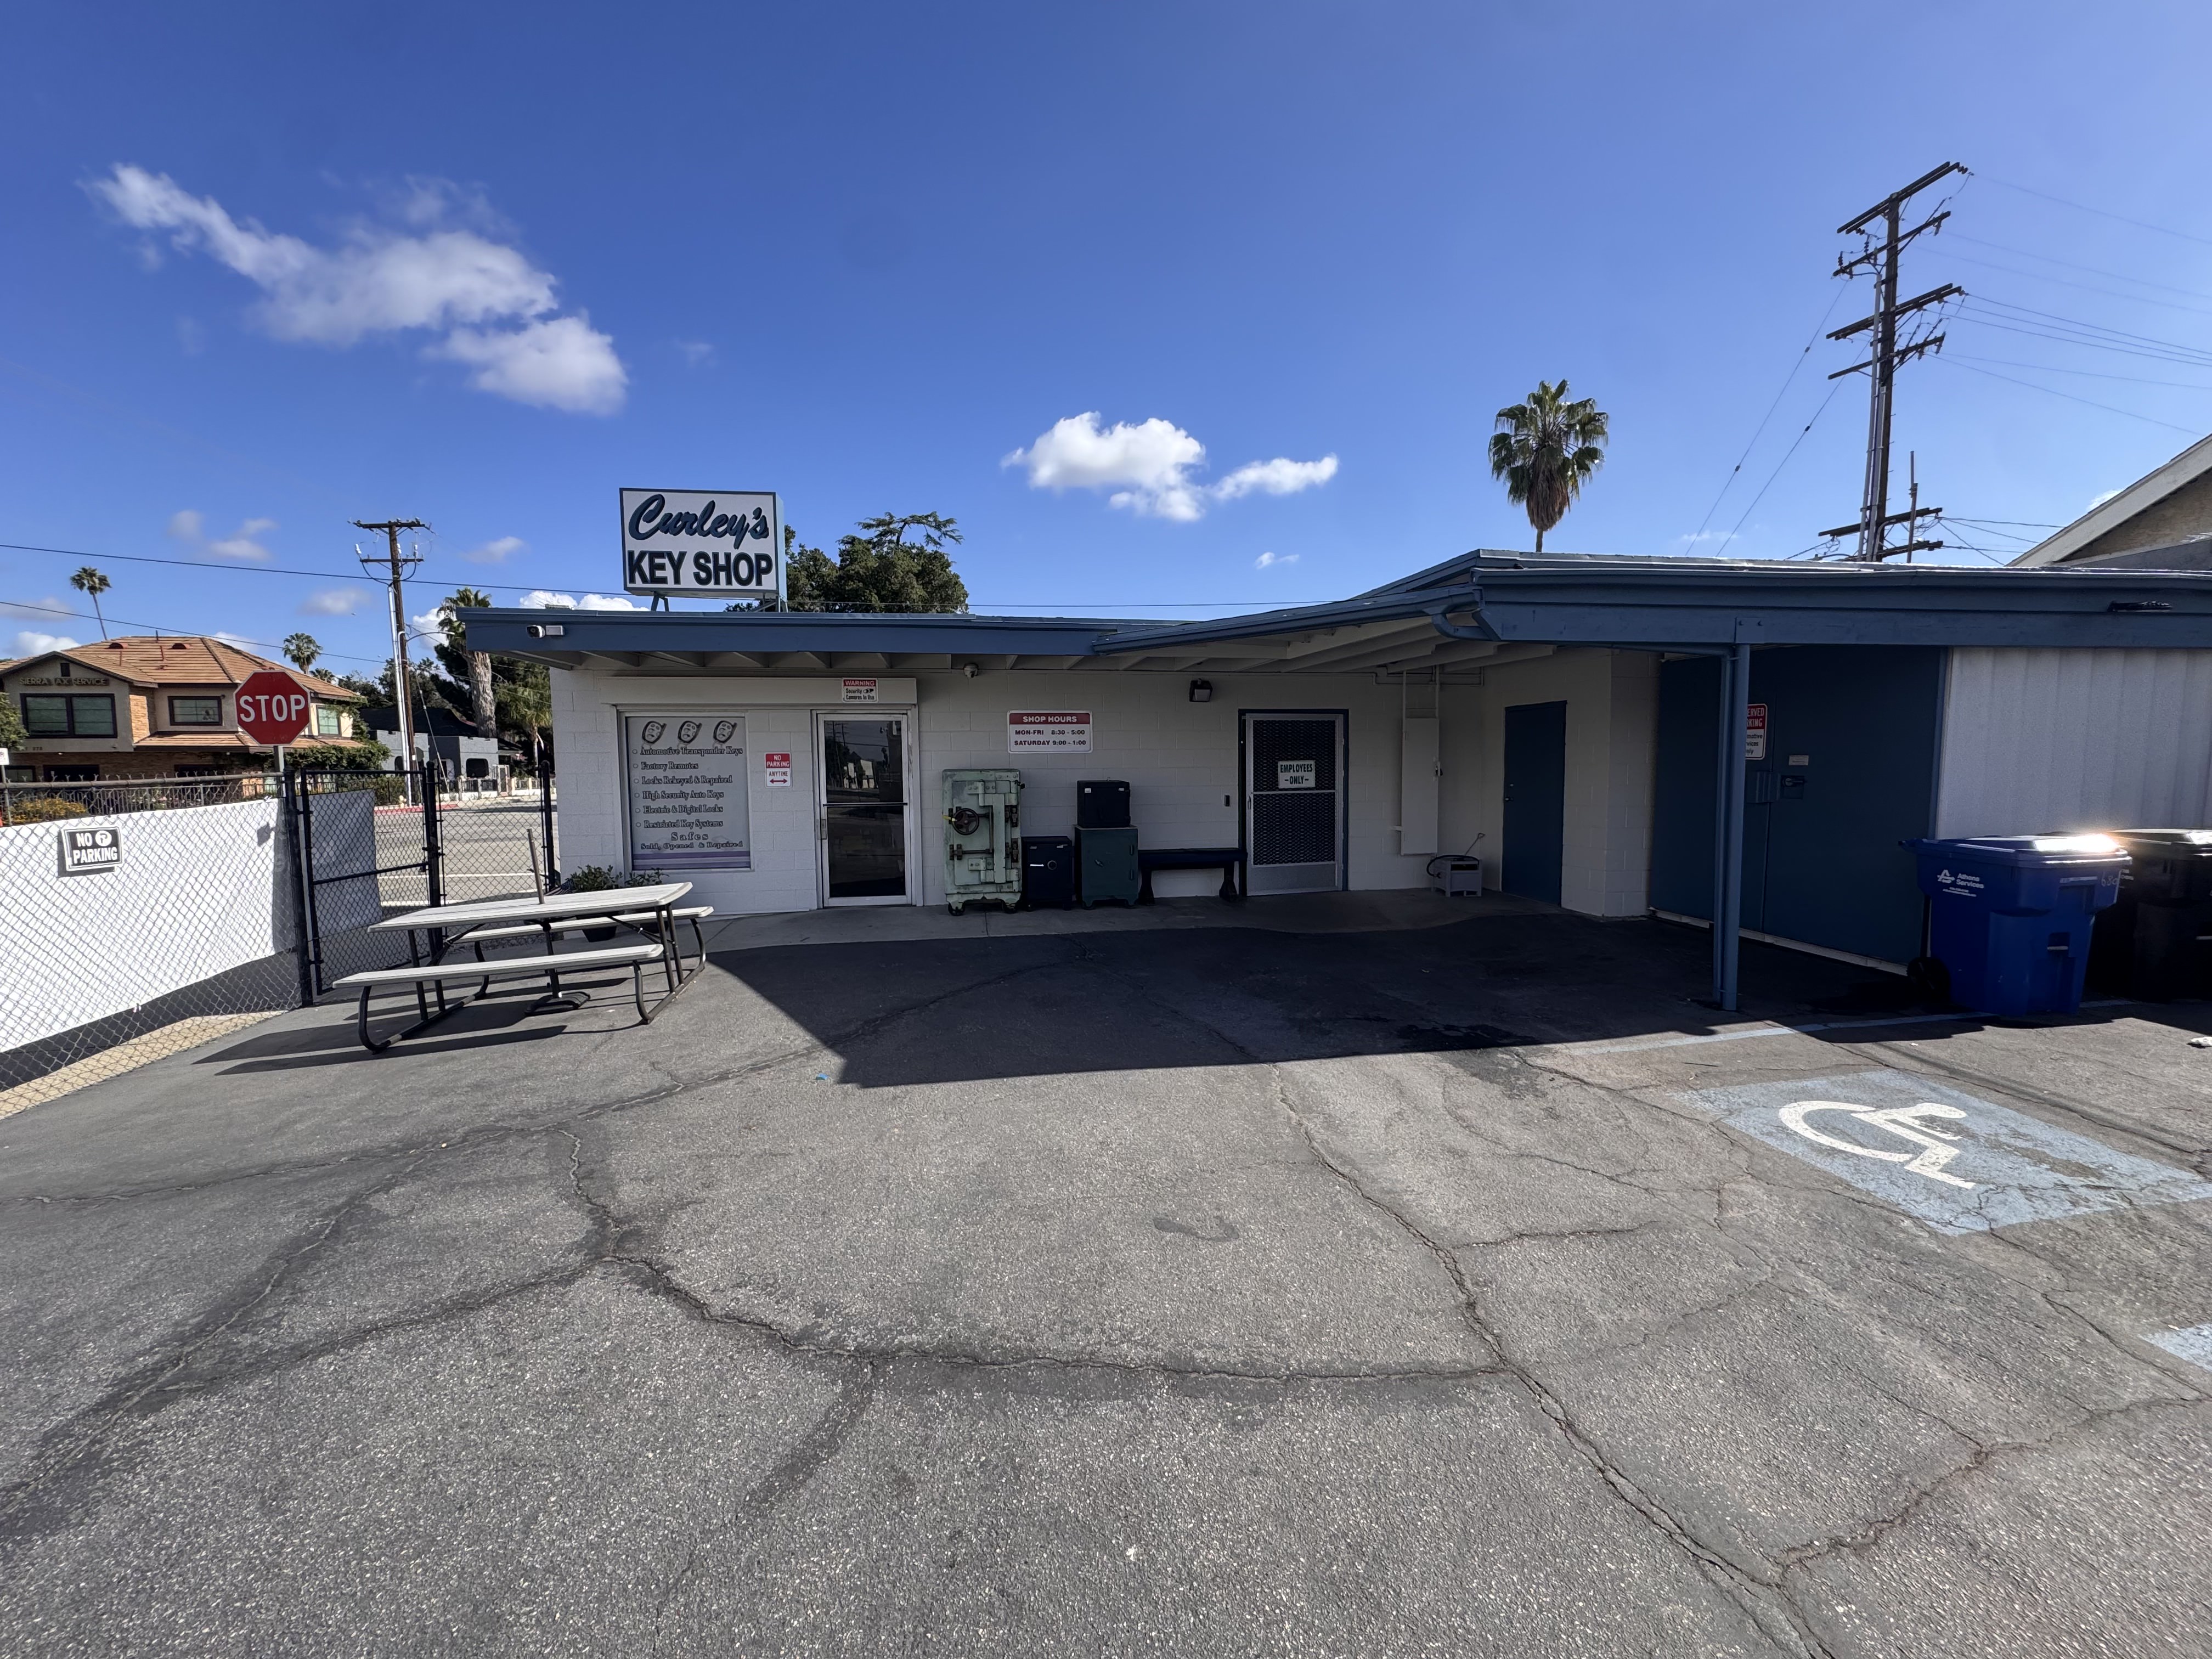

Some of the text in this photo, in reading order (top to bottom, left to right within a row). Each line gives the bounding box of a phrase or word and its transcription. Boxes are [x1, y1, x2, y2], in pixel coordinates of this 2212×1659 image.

[629, 494, 769, 549] Curley's
[627, 550, 773, 586] KEY SHOP
[240, 695, 305, 722] STOP
[640, 746, 743, 757] Automotive Transponder Keys
[641, 761, 698, 771] Factory Remotes
[1280, 764, 1313, 773] EMPLOYEES
[642, 776, 663, 785] Locks
[663, 776, 693, 786] Rekeyed
[701, 775, 732, 786] Repaired
[642, 790, 724, 801] High Security Auto Keys
[678, 805, 702, 815] Digital
[703, 804, 723, 812] Locks
[680, 820, 694, 830] Key
[695, 819, 723, 829] Systems
[76, 832, 93, 847] NO
[671, 832, 708, 840] Safes
[73, 847, 118, 864] PARKING
[1957, 873, 1980, 882] Athens
[1956, 879, 1984, 889] Services
